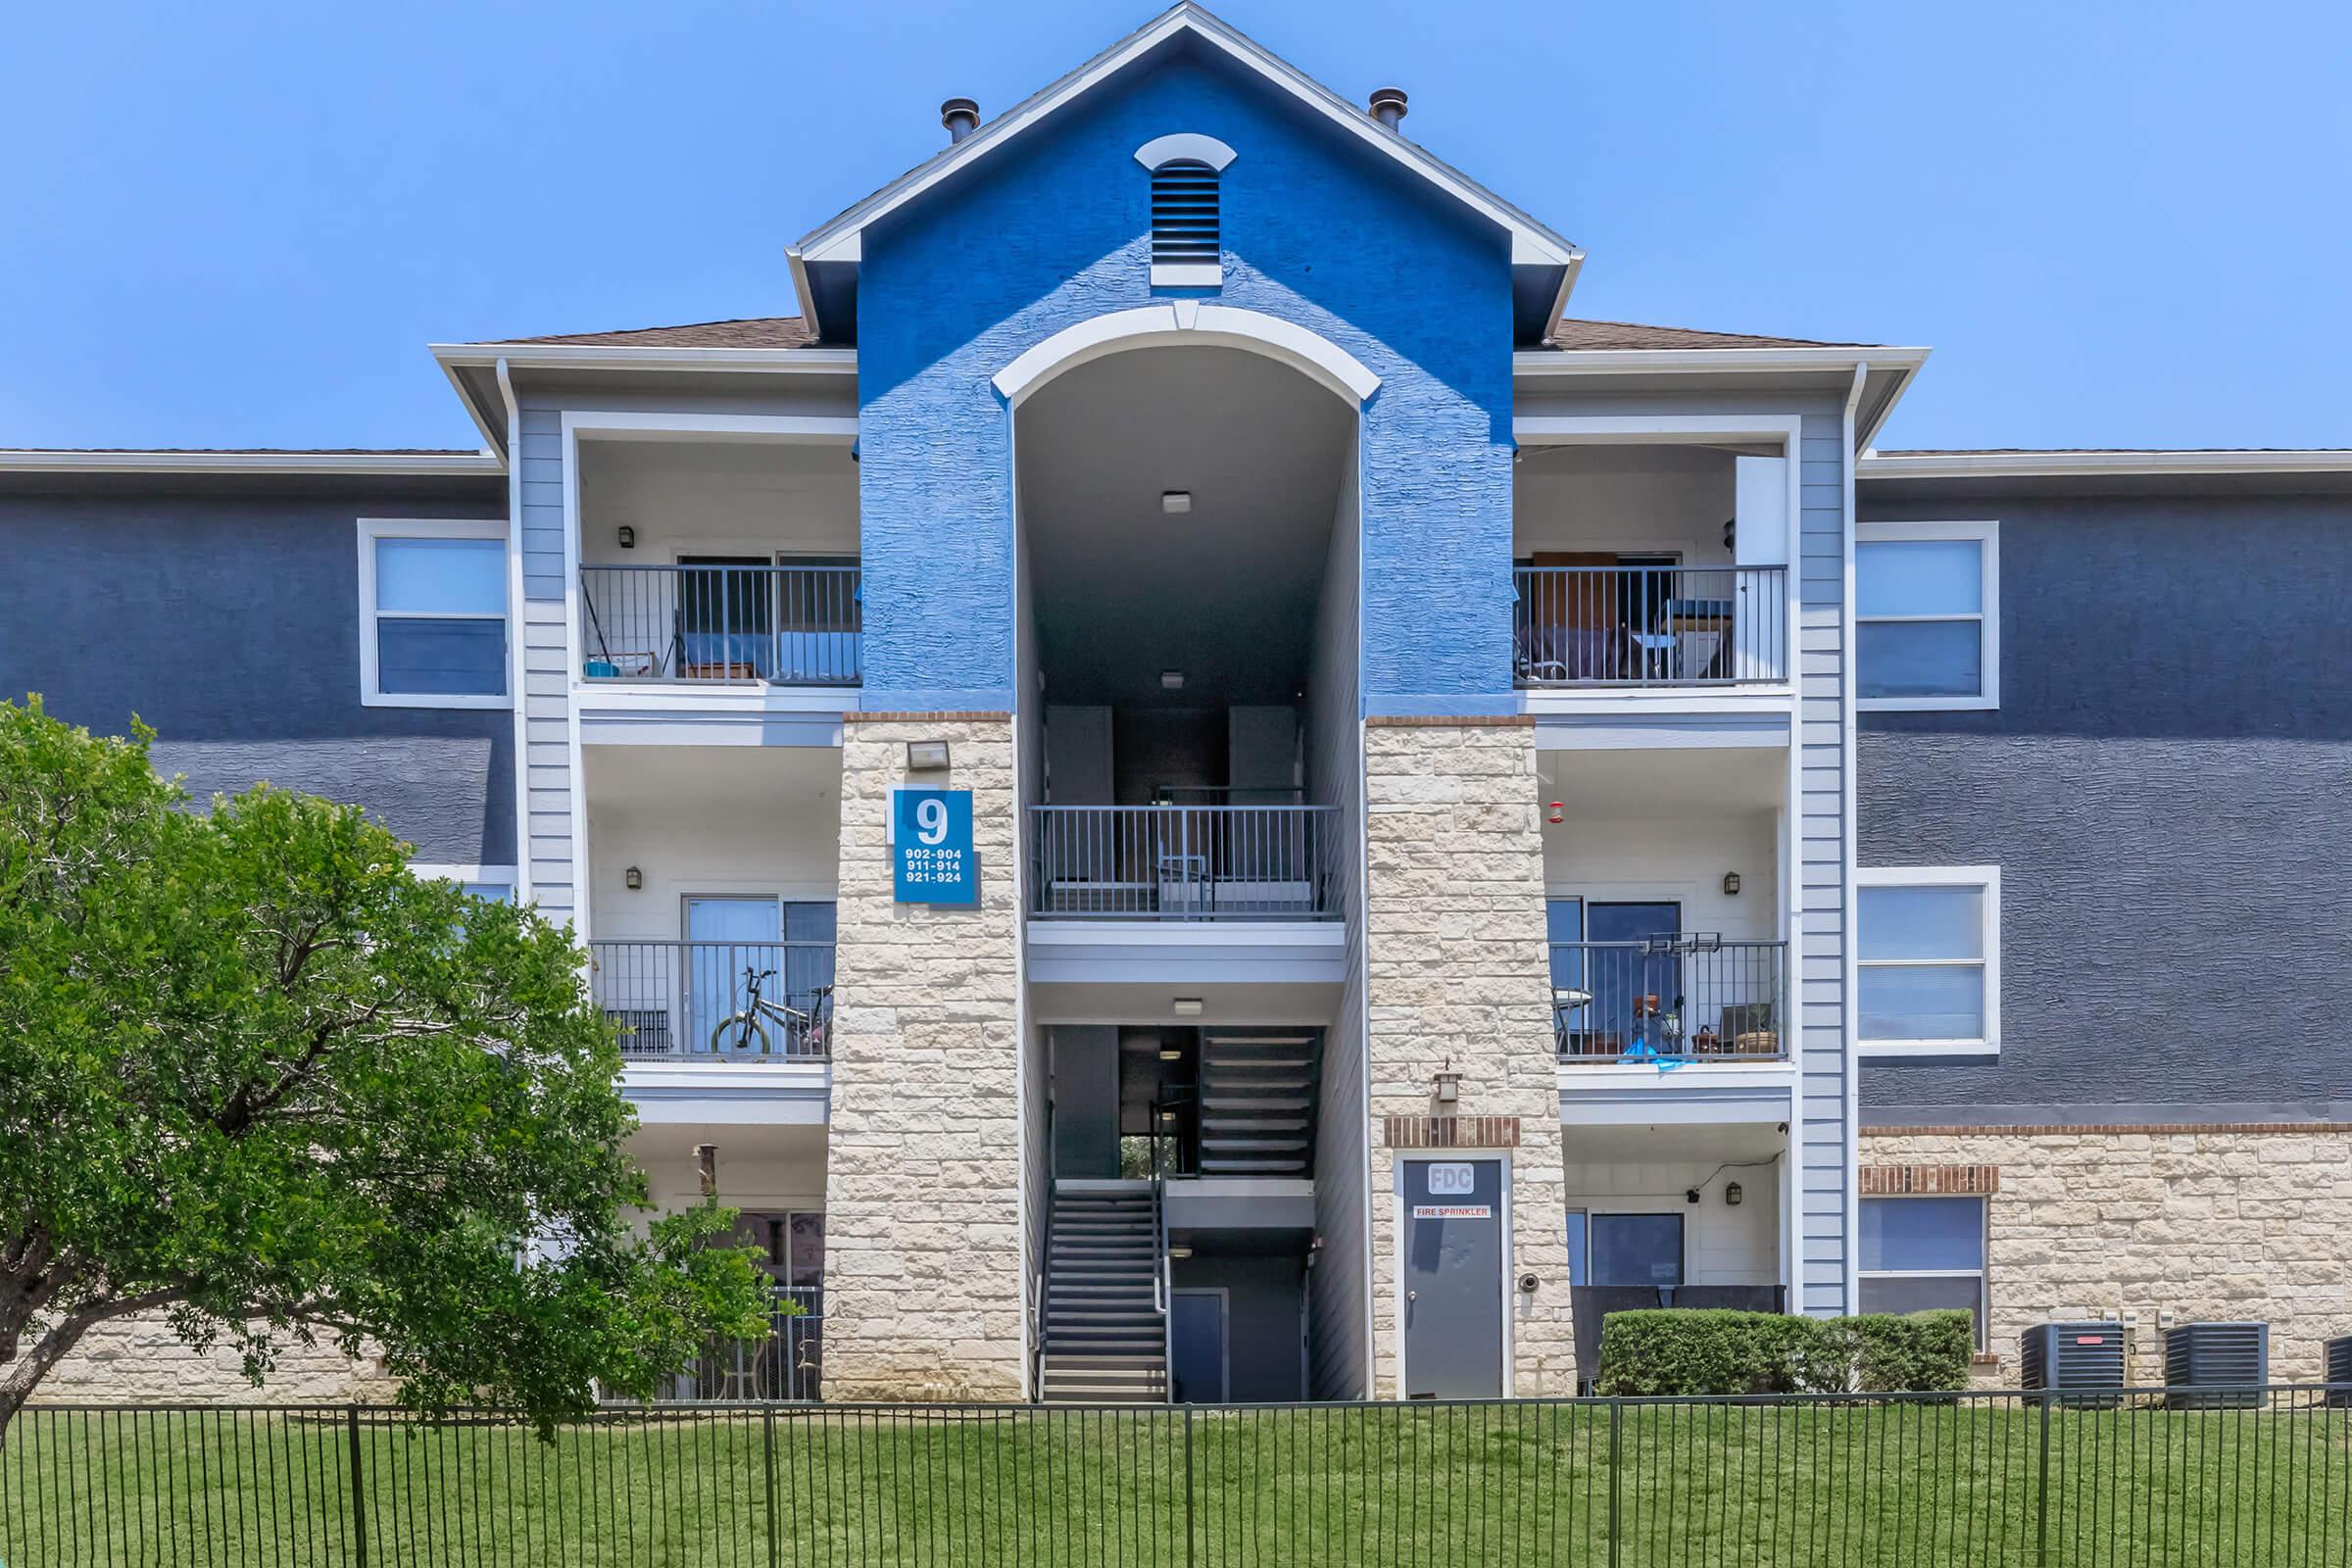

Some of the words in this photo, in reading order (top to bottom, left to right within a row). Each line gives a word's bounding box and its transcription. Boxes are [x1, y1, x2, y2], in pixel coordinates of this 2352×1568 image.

[916, 799, 948, 845] 9
[905, 849, 961, 858] 902-904
[906, 860, 960, 870] 911-914
[906, 872, 961, 882] 921-924
[1430, 1167, 1471, 1189] FDC
